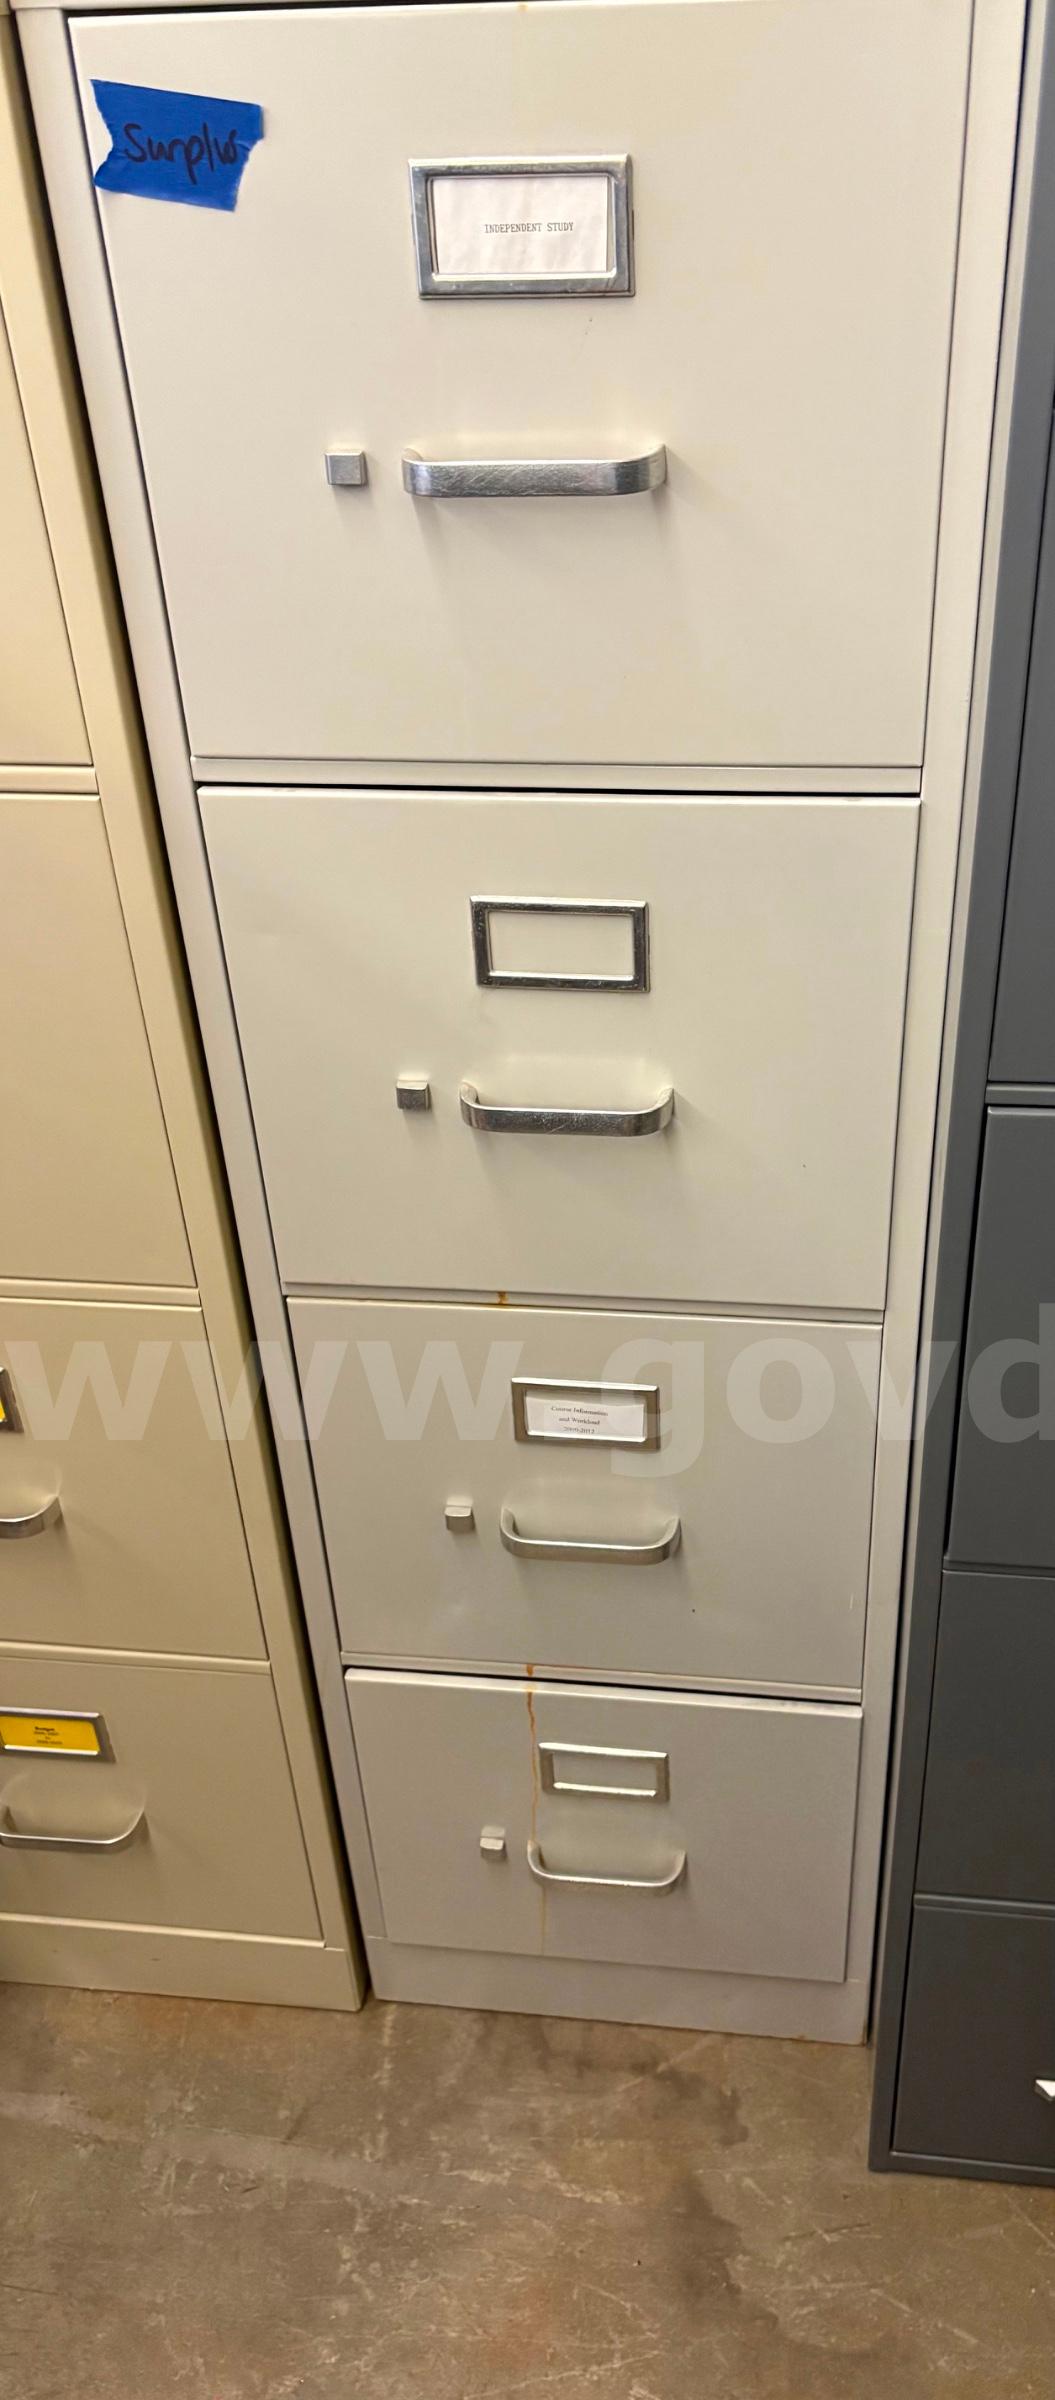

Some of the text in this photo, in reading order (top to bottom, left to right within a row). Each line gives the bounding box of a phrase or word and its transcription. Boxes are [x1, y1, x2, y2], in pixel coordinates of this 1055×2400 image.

[123, 122, 238, 185] Surplus
[484, 221, 574, 234] INDEPENDENT STUDY
